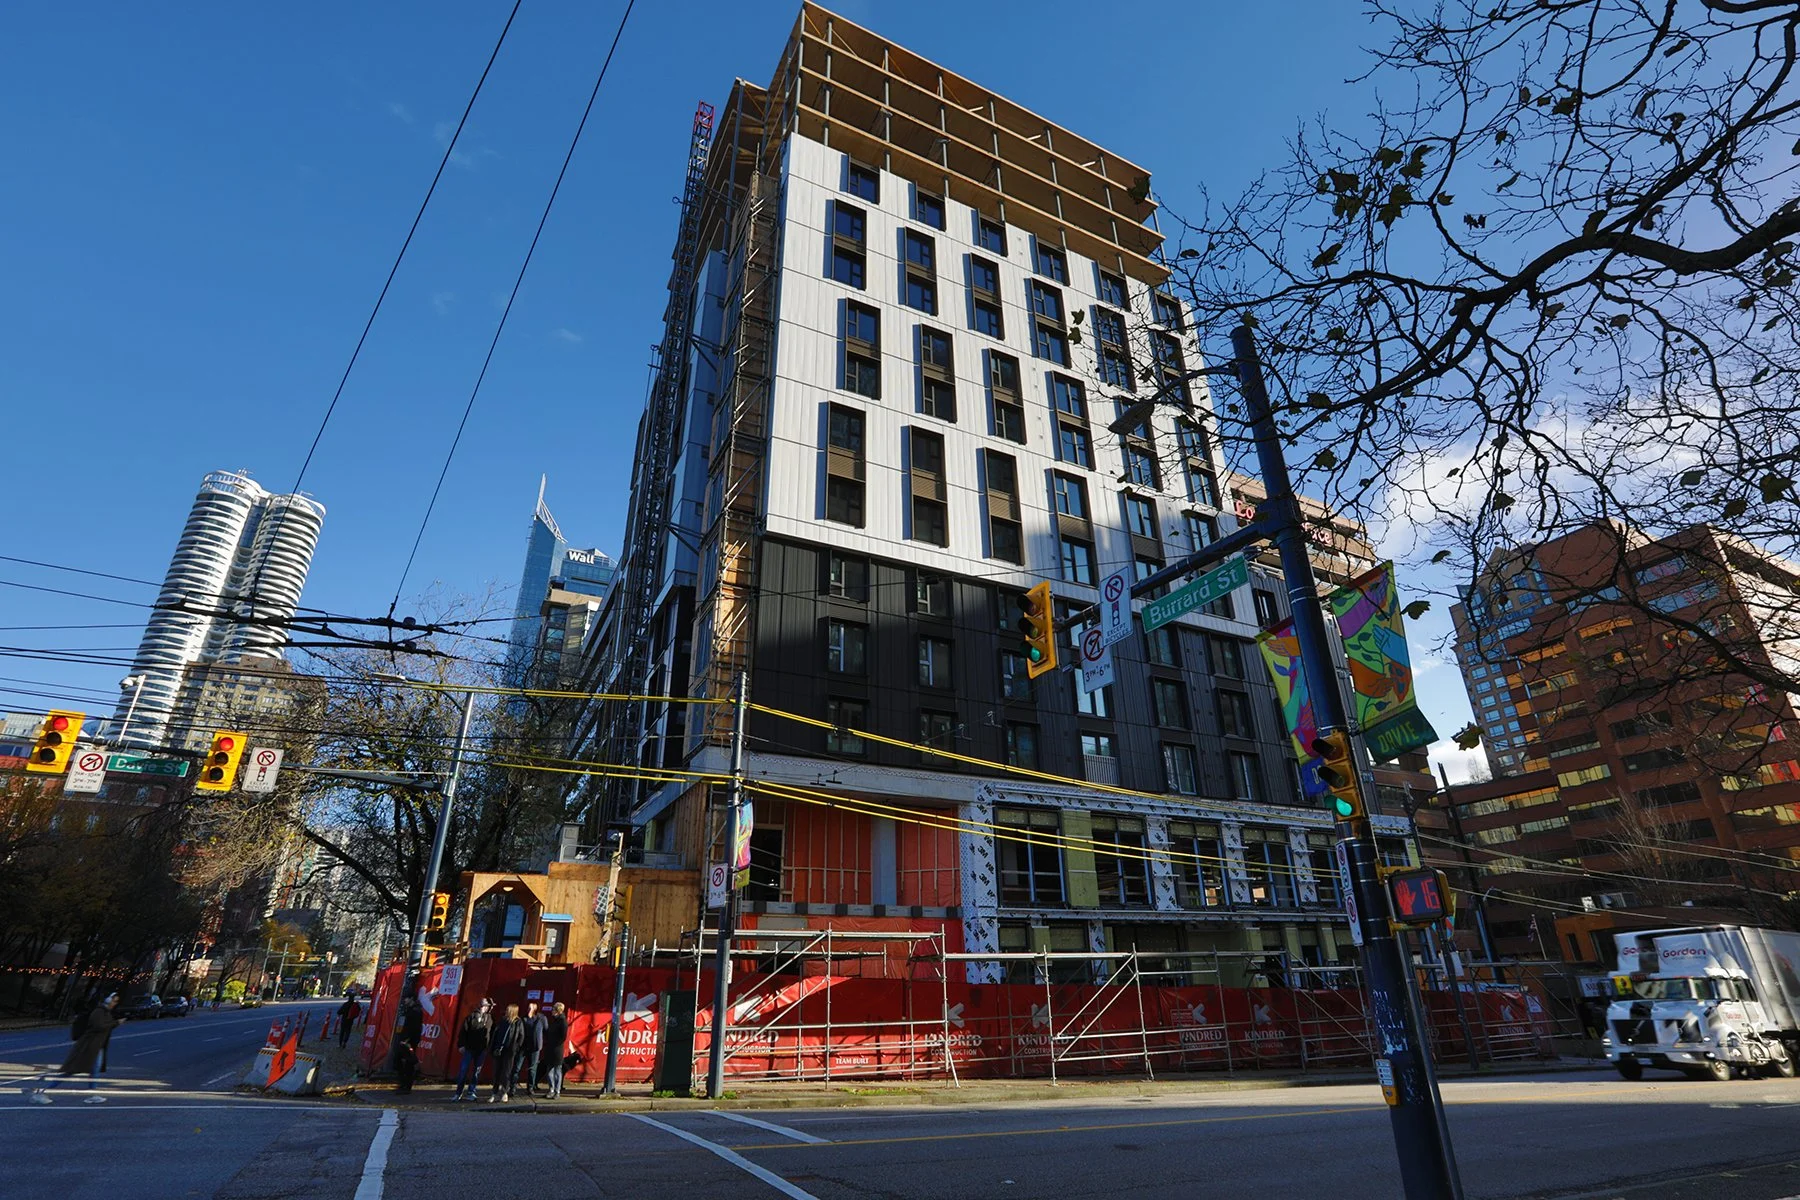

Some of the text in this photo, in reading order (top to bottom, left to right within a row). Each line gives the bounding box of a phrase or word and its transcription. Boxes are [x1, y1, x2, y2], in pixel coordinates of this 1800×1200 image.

[567, 550, 595, 565] Wall
[1149, 568, 1239, 624] Burrard St
[1105, 628, 1129, 644] BICYCLES
[1106, 622, 1127, 637] EXCEPT
[1377, 721, 1420, 753] DAVIE
[115, 758, 158, 772] Davie
[1421, 878, 1441, 910] 16
[1662, 947, 1707, 958] Gordon
[445, 967, 458, 979] 981
[596, 1029, 658, 1044] KNDR
[725, 1030, 779, 1043] NDRED
